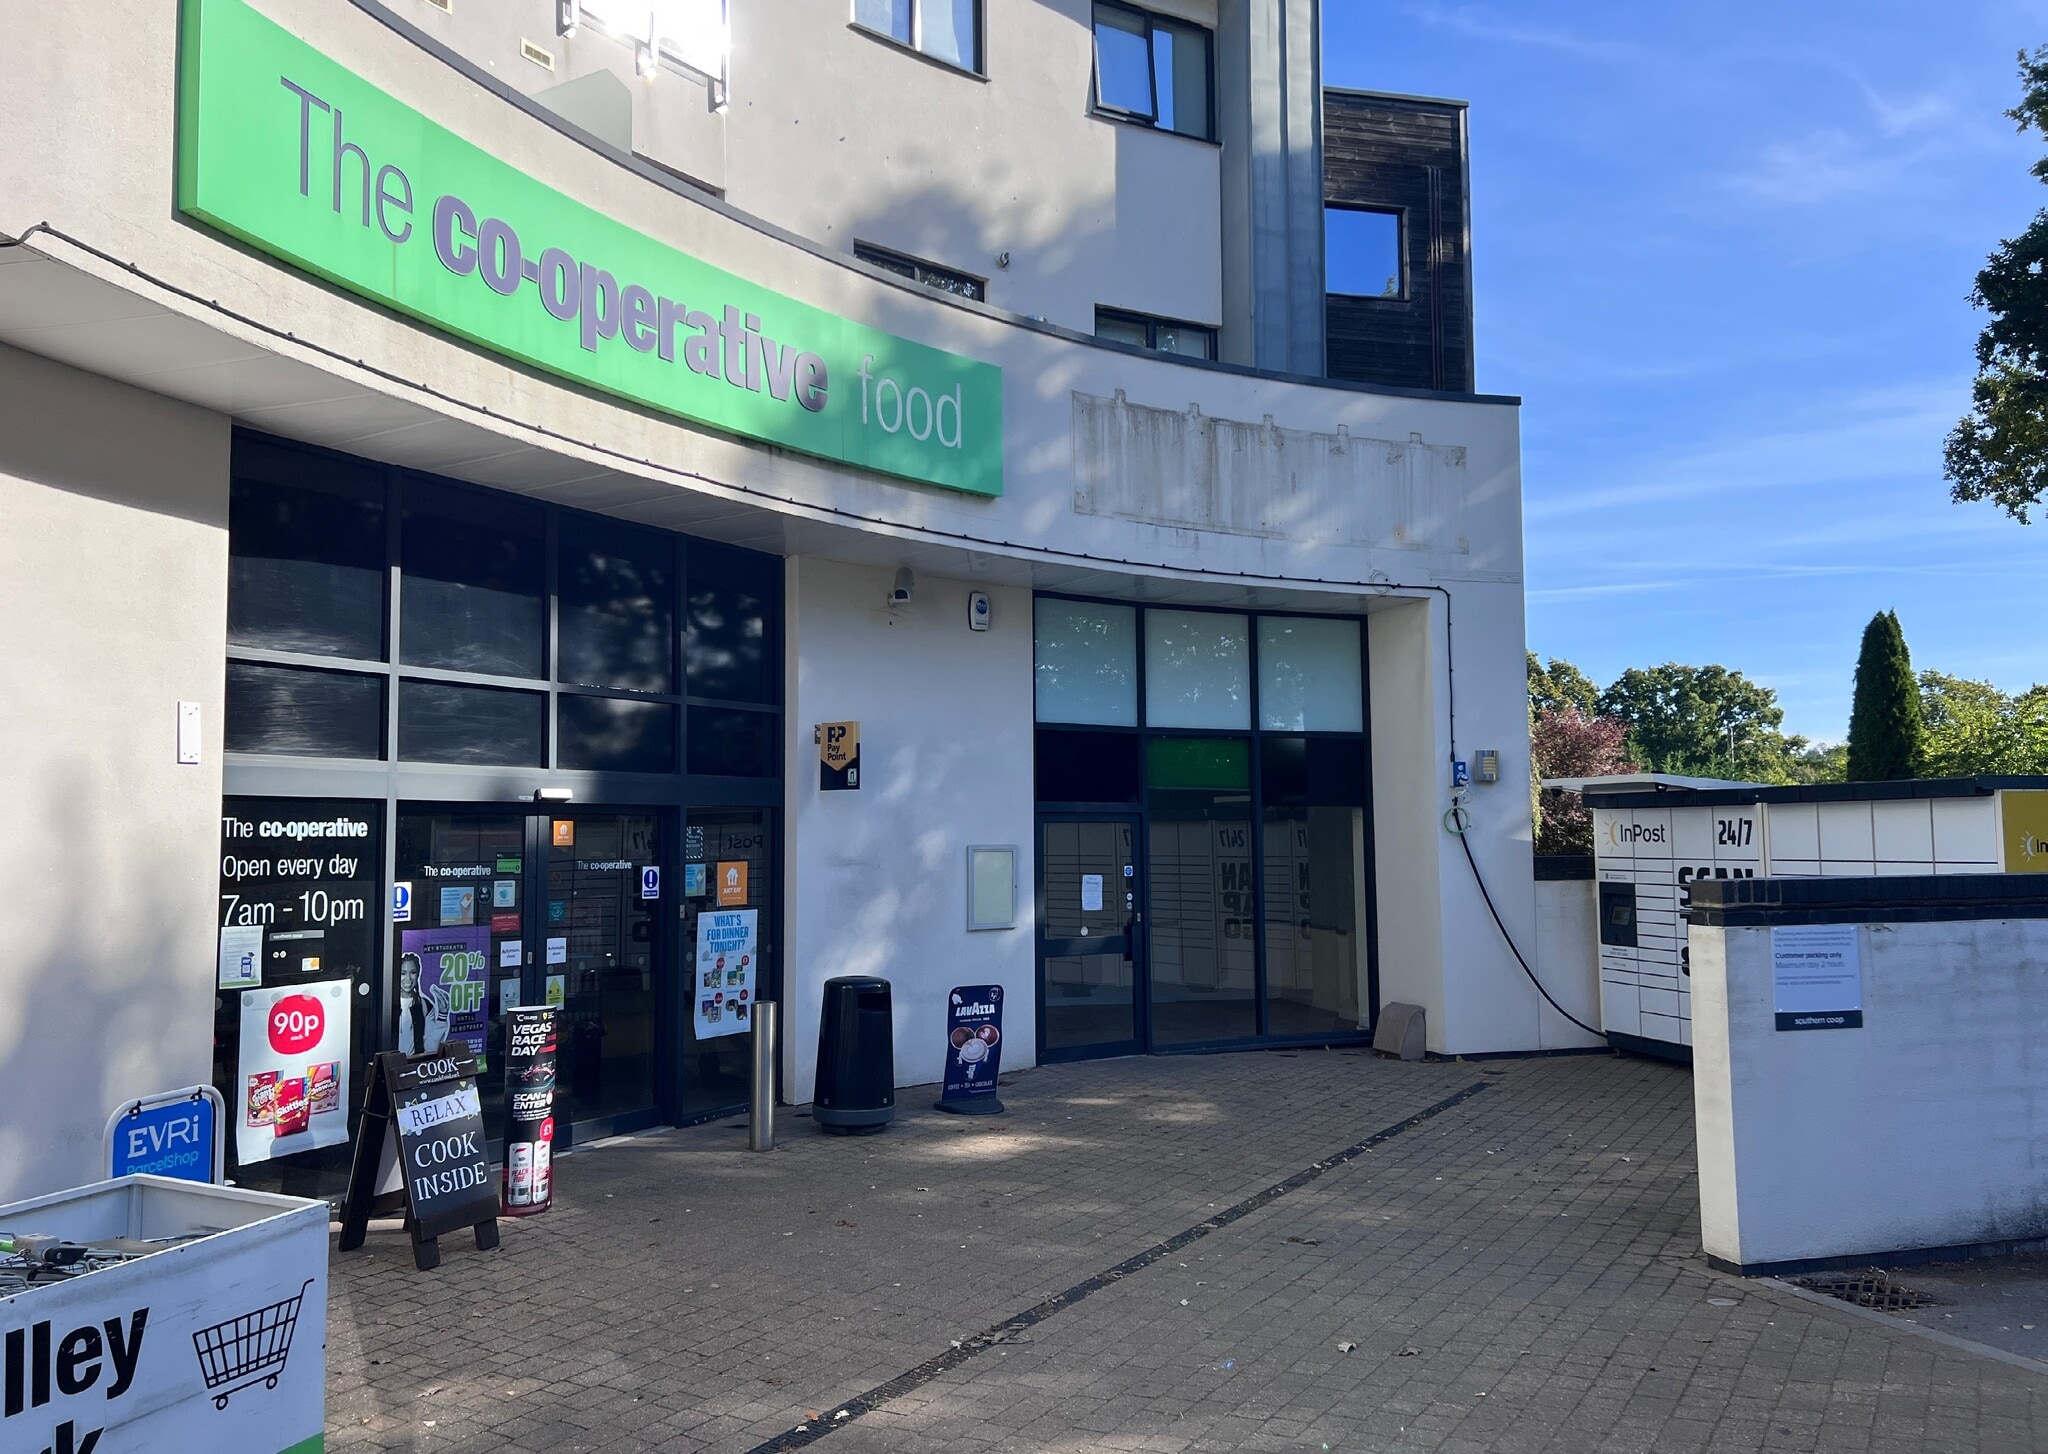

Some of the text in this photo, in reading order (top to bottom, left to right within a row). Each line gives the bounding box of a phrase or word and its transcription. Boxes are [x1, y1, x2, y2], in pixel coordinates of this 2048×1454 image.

[280, 75, 962, 449] The co-operative food
[827, 744, 840, 753] Pay
[827, 752, 847, 761] Point
[222, 817, 368, 841] The co-operative
[1620, 824, 1666, 843] InPost
[1718, 818, 1753, 847] 24/7
[222, 854, 358, 881] Open every day
[424, 865, 491, 878] The co-operative
[577, 860, 633, 872] The co-operative
[221, 894, 275, 927] 7am
[299, 890, 364, 926] 10pm
[714, 914, 742, 927] WHAT'S
[707, 926, 749, 940] FOR DINNER
[710, 939, 746, 953] TONIGHT?
[1829, 951, 1842, 959] only
[440, 950, 486, 986] 20%
[450, 981, 486, 1014] OFF
[955, 1002, 996, 1017] LAVAZZA
[274, 1010, 319, 1037] 90p
[512, 1022, 552, 1035] VEGAS
[1794, 1017, 1825, 1025] southern
[511, 1034, 547, 1046] RACE
[511, 1045, 540, 1056] DAY
[417, 1057, 459, 1079] COOK
[513, 1092, 541, 1101] SCAN
[513, 1099, 547, 1110] ENTER
[276, 1098, 309, 1118] Skittles
[411, 1095, 466, 1127] RELAX
[127, 1114, 199, 1159] EVRi
[414, 1131, 479, 1168] COOK
[126, 1150, 199, 1175] ParcelShop
[414, 1161, 487, 1201] INSIDE
